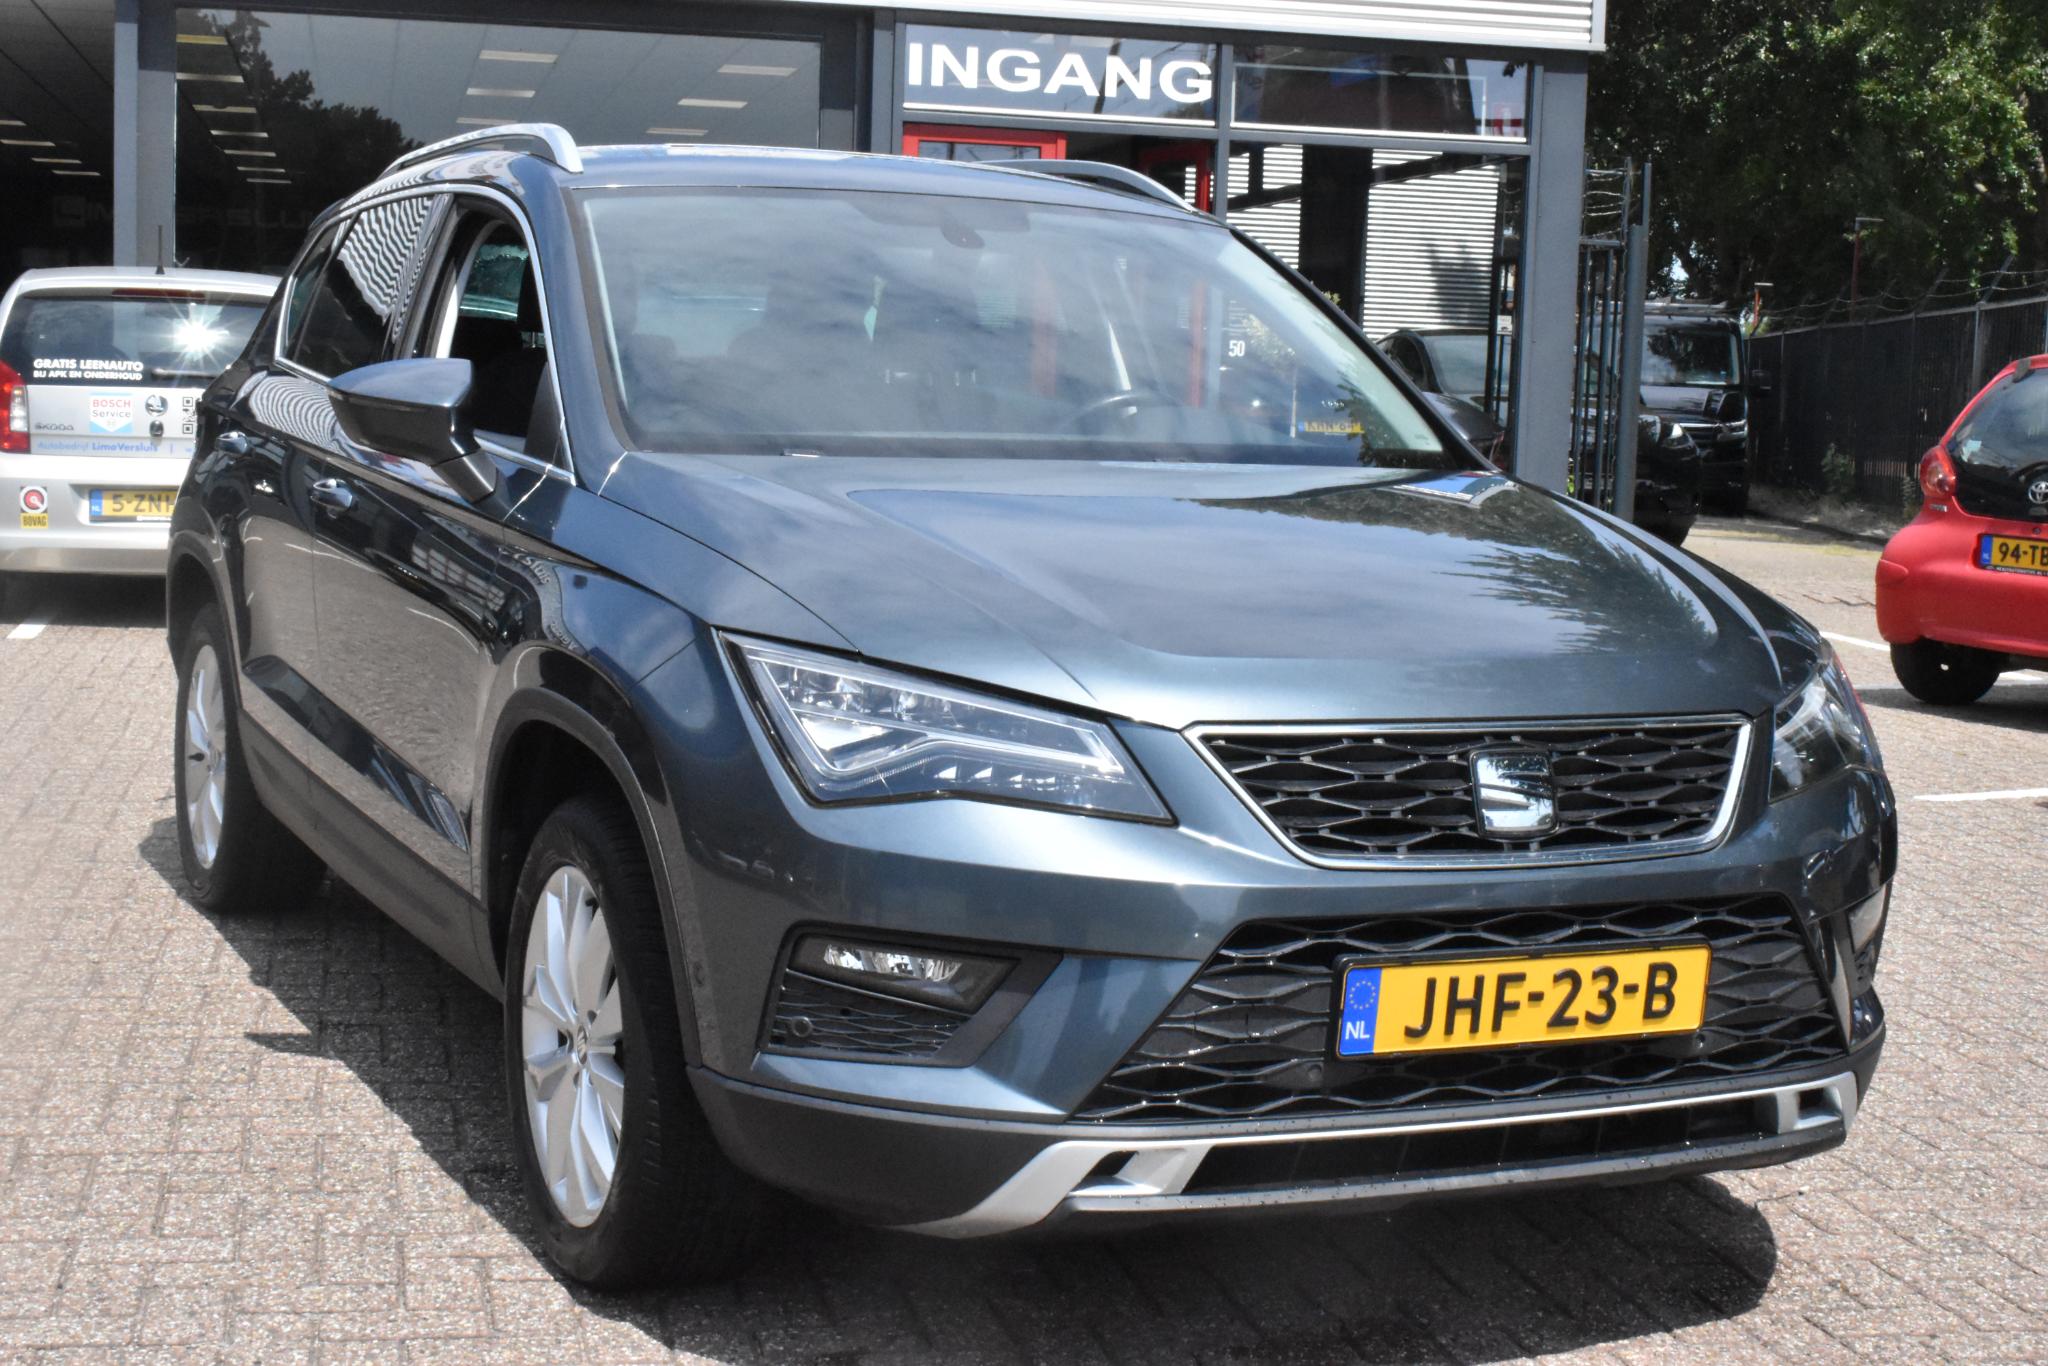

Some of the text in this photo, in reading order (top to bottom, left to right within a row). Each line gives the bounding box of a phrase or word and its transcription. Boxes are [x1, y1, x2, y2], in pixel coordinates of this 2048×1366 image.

[908, 42, 1213, 104] INGANG
[1228, 339, 1246, 358] 50
[33, 358, 144, 372] GRATIS LEENAUTO
[33, 370, 143, 381] BIJ APK EN ONDERHOUD
[92, 399, 131, 408] BOSCH
[92, 409, 131, 418] Service
[23, 515, 47, 526] BOVAG
[1403, 961, 1679, 1040] JHF-23-B
[1345, 1020, 1371, 1040] NL
